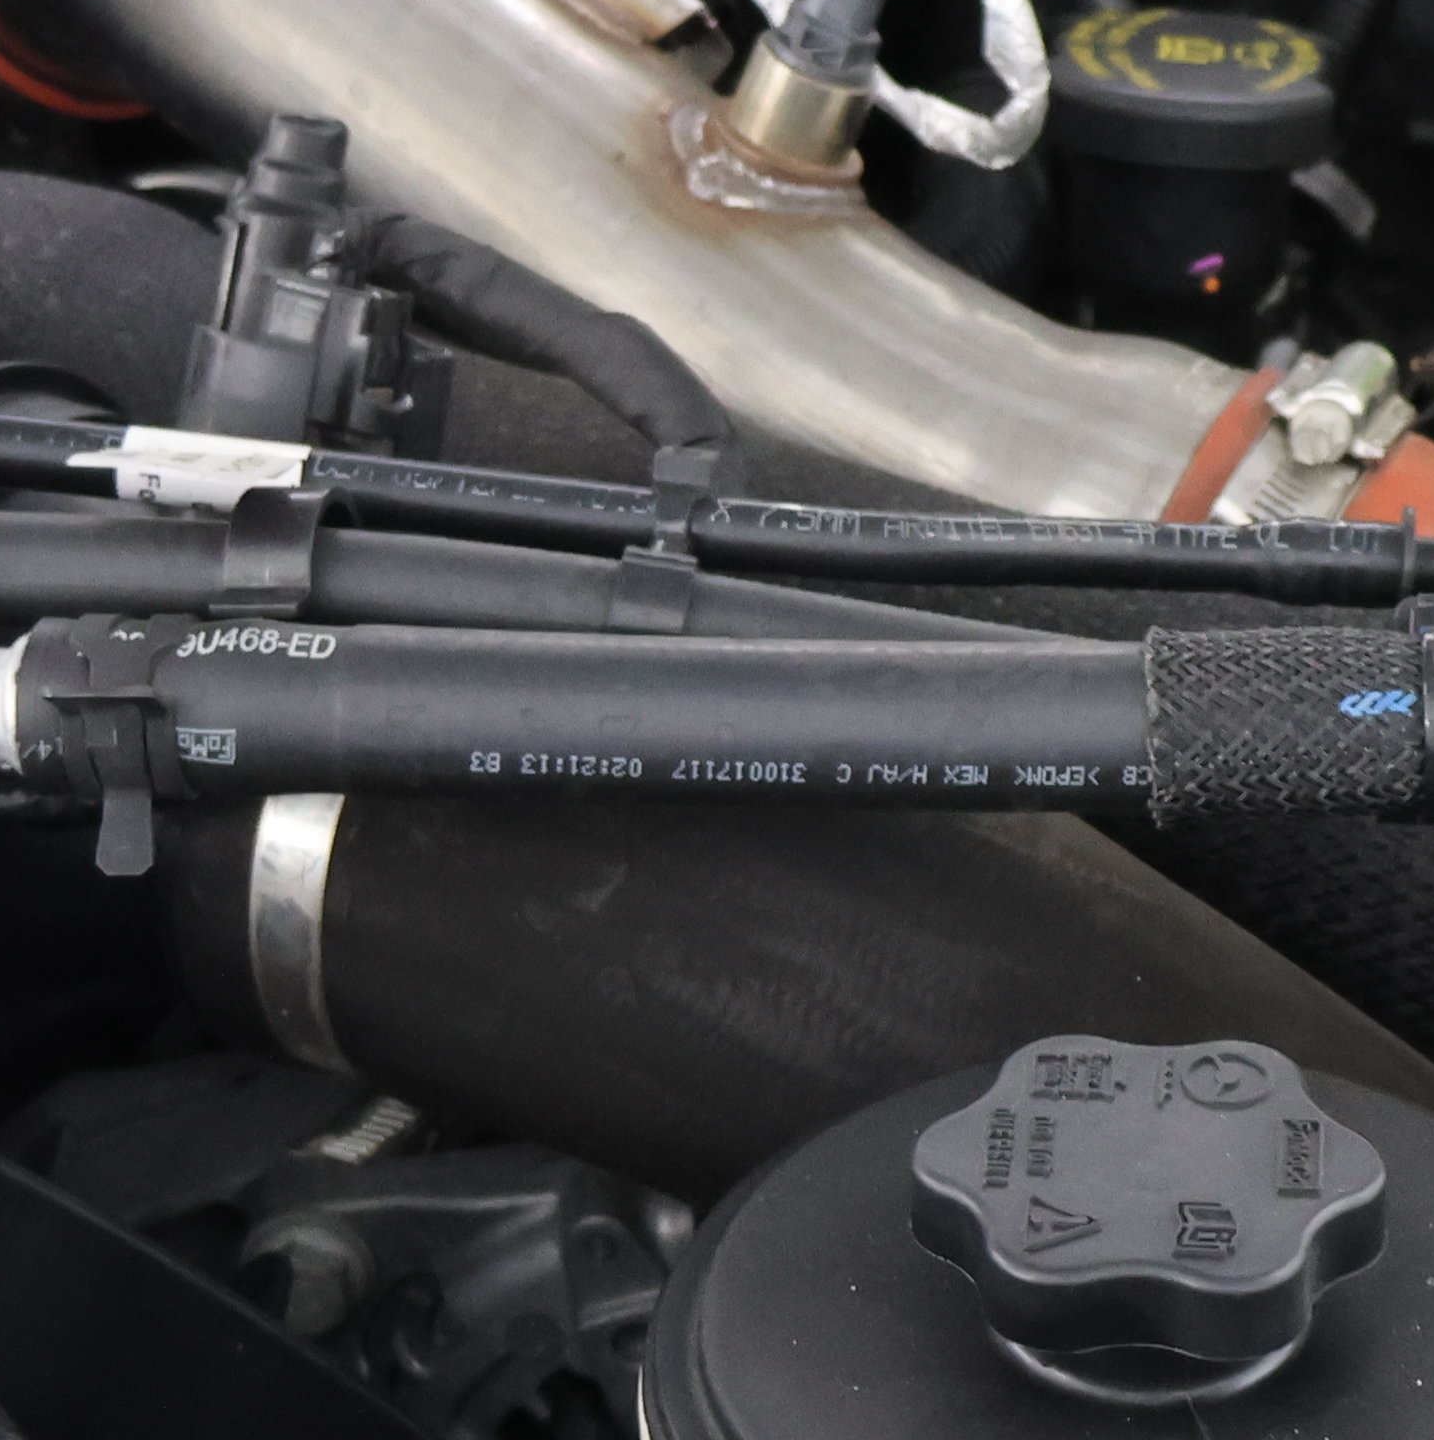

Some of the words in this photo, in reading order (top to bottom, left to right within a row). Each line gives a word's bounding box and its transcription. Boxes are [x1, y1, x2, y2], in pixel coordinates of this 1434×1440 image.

[519, 752, 643, 779] 02:21:13
[670, 759, 809, 784] 310017117
[942, 764, 990, 786] MEX
